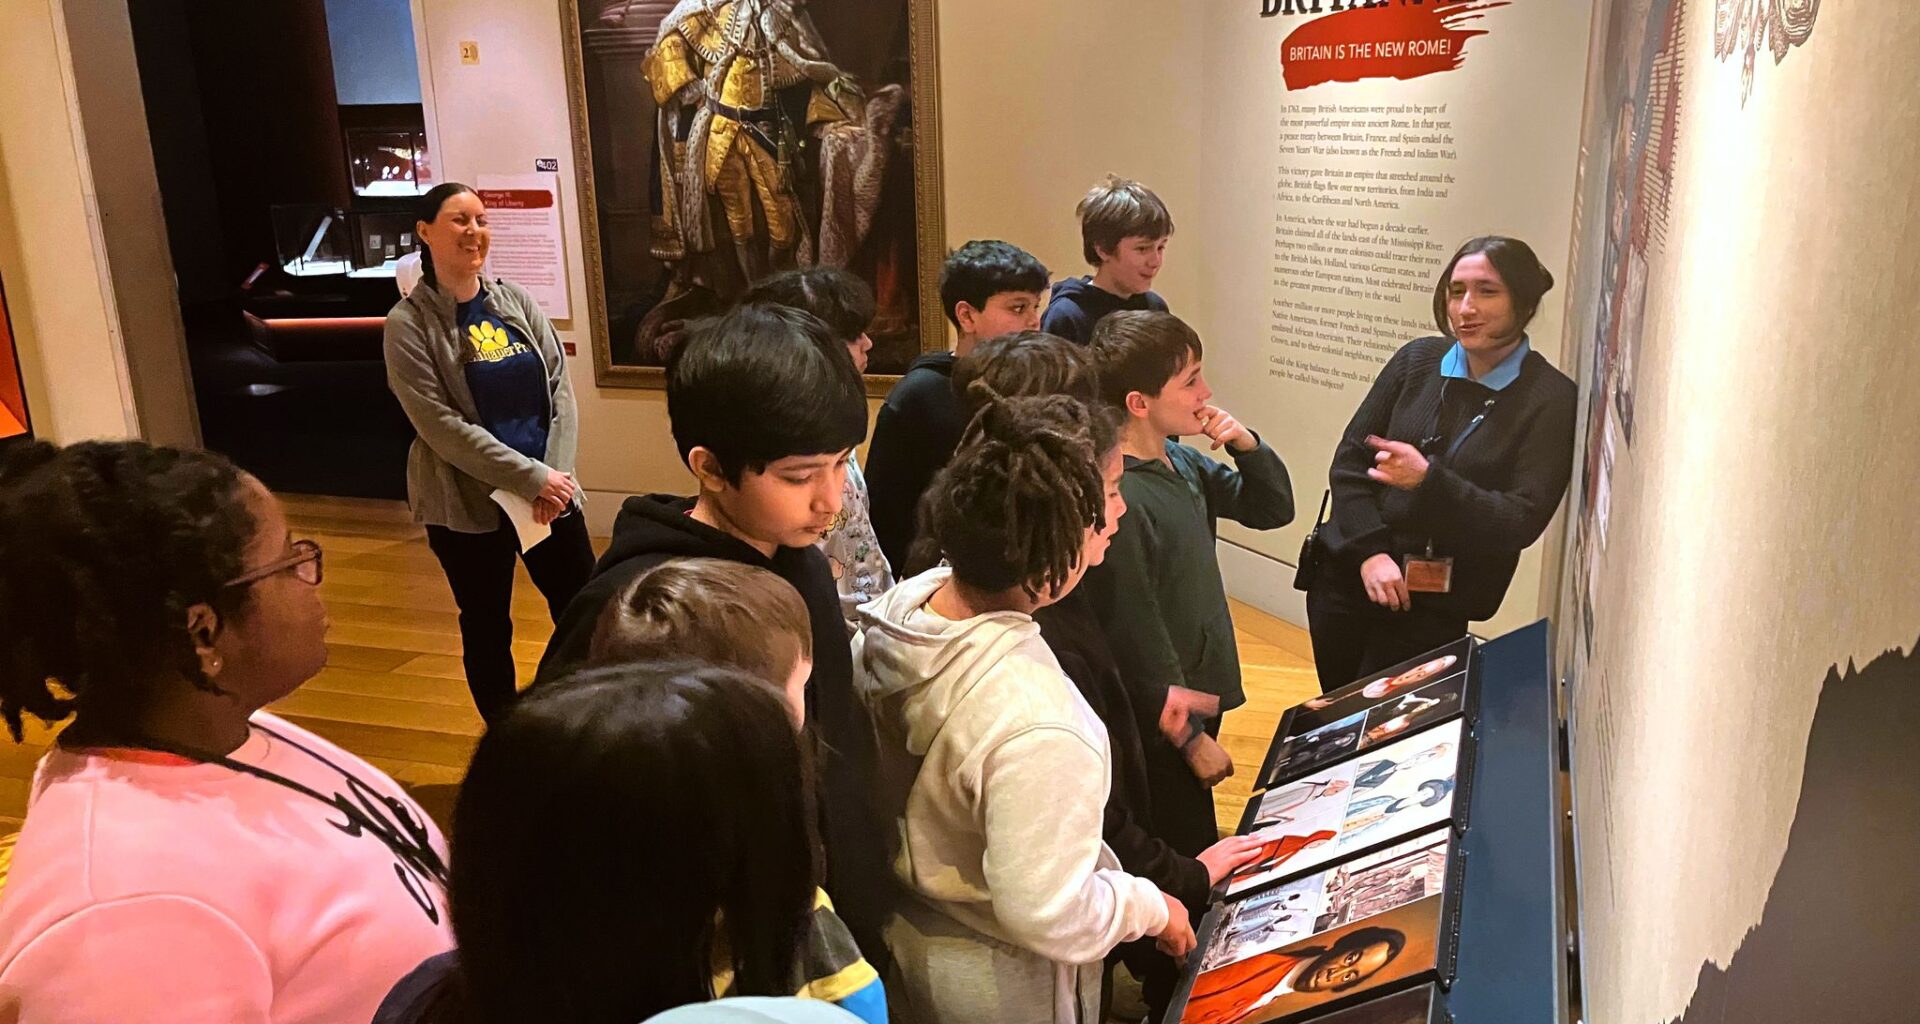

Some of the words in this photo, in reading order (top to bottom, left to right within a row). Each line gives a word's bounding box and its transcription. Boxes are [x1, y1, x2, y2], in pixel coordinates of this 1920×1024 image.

[1289, 45, 1332, 61] BRITAIN
[1335, 44, 1345, 60] IS
[1348, 43, 1372, 59] THE
[1375, 41, 1405, 57] NEW
[1408, 39, 1451, 56] ROME!
[1338, 105, 1369, 113] Americans
[1385, 105, 1404, 115] proud
[1413, 105, 1422, 113] be
[1423, 106, 1437, 115] part
[1438, 105, 1448, 113] of
[1280, 118, 1289, 126] the
[1303, 118, 1328, 129] powerful
[1329, 119, 1350, 129] empire
[1351, 119, 1366, 127] since
[1367, 119, 1389, 127] ancient
[1420, 120, 1434, 128] that
[1299, 133, 1316, 143] treaty
[1317, 132, 1341, 141] between
[1389, 134, 1400, 142] and
[1402, 134, 1420, 145] Spain
[1421, 135, 1441, 143] ended
[1442, 135, 1453, 143] the
[542, 161, 557, 170] 402
[1301, 194, 1310, 203] the
[1311, 195, 1340, 205] Caribbean
[1341, 197, 1352, 206] and
[1353, 198, 1371, 207] North
[1307, 216, 1324, 225] where
[1325, 218, 1334, 226] the
[1348, 220, 1359, 228] had
[1360, 221, 1378, 232] begun
[1384, 223, 1406, 233] decade
[1407, 225, 1429, 235] earlier.
